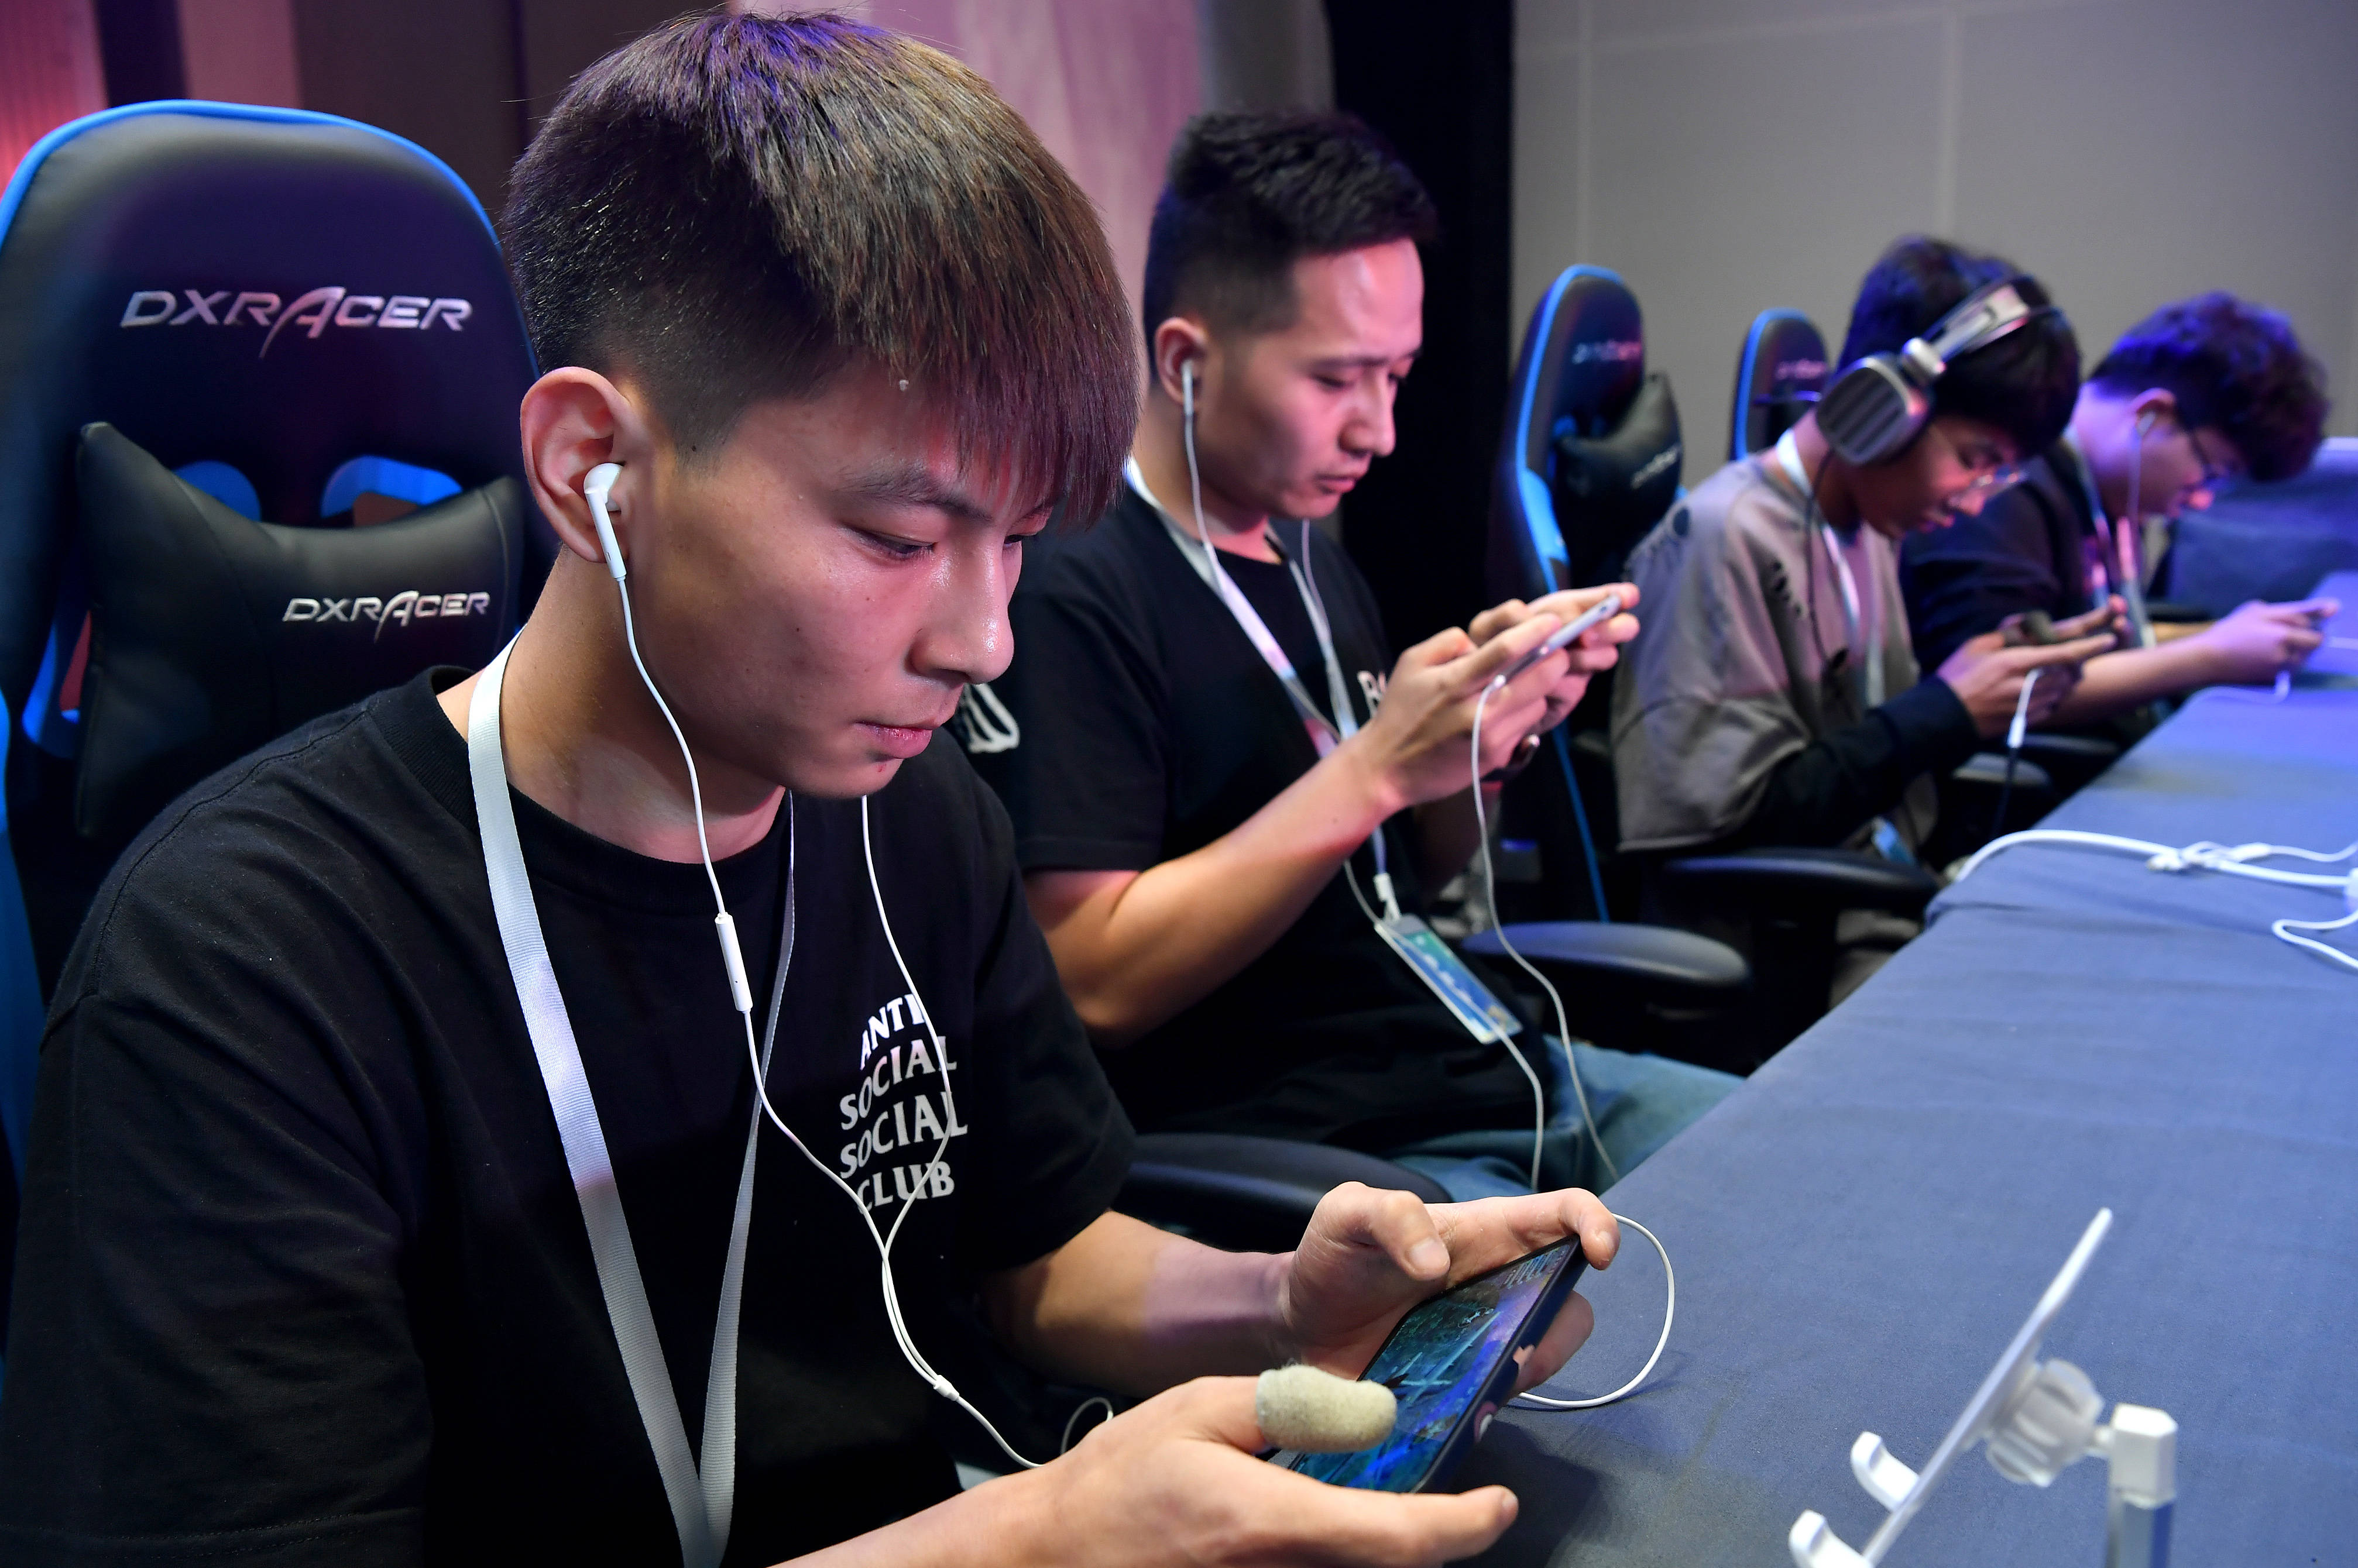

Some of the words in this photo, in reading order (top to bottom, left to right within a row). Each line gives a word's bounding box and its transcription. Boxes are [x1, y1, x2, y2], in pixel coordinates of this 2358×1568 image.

[121, 286, 472, 358] DXRACER
[282, 590, 489, 644] DXRACER
[859, 993, 926, 1071] ANTI
[839, 1036, 957, 1130] SOCIAL
[840, 1091, 968, 1179] SOCIAL
[857, 1161, 955, 1215] CLUB
